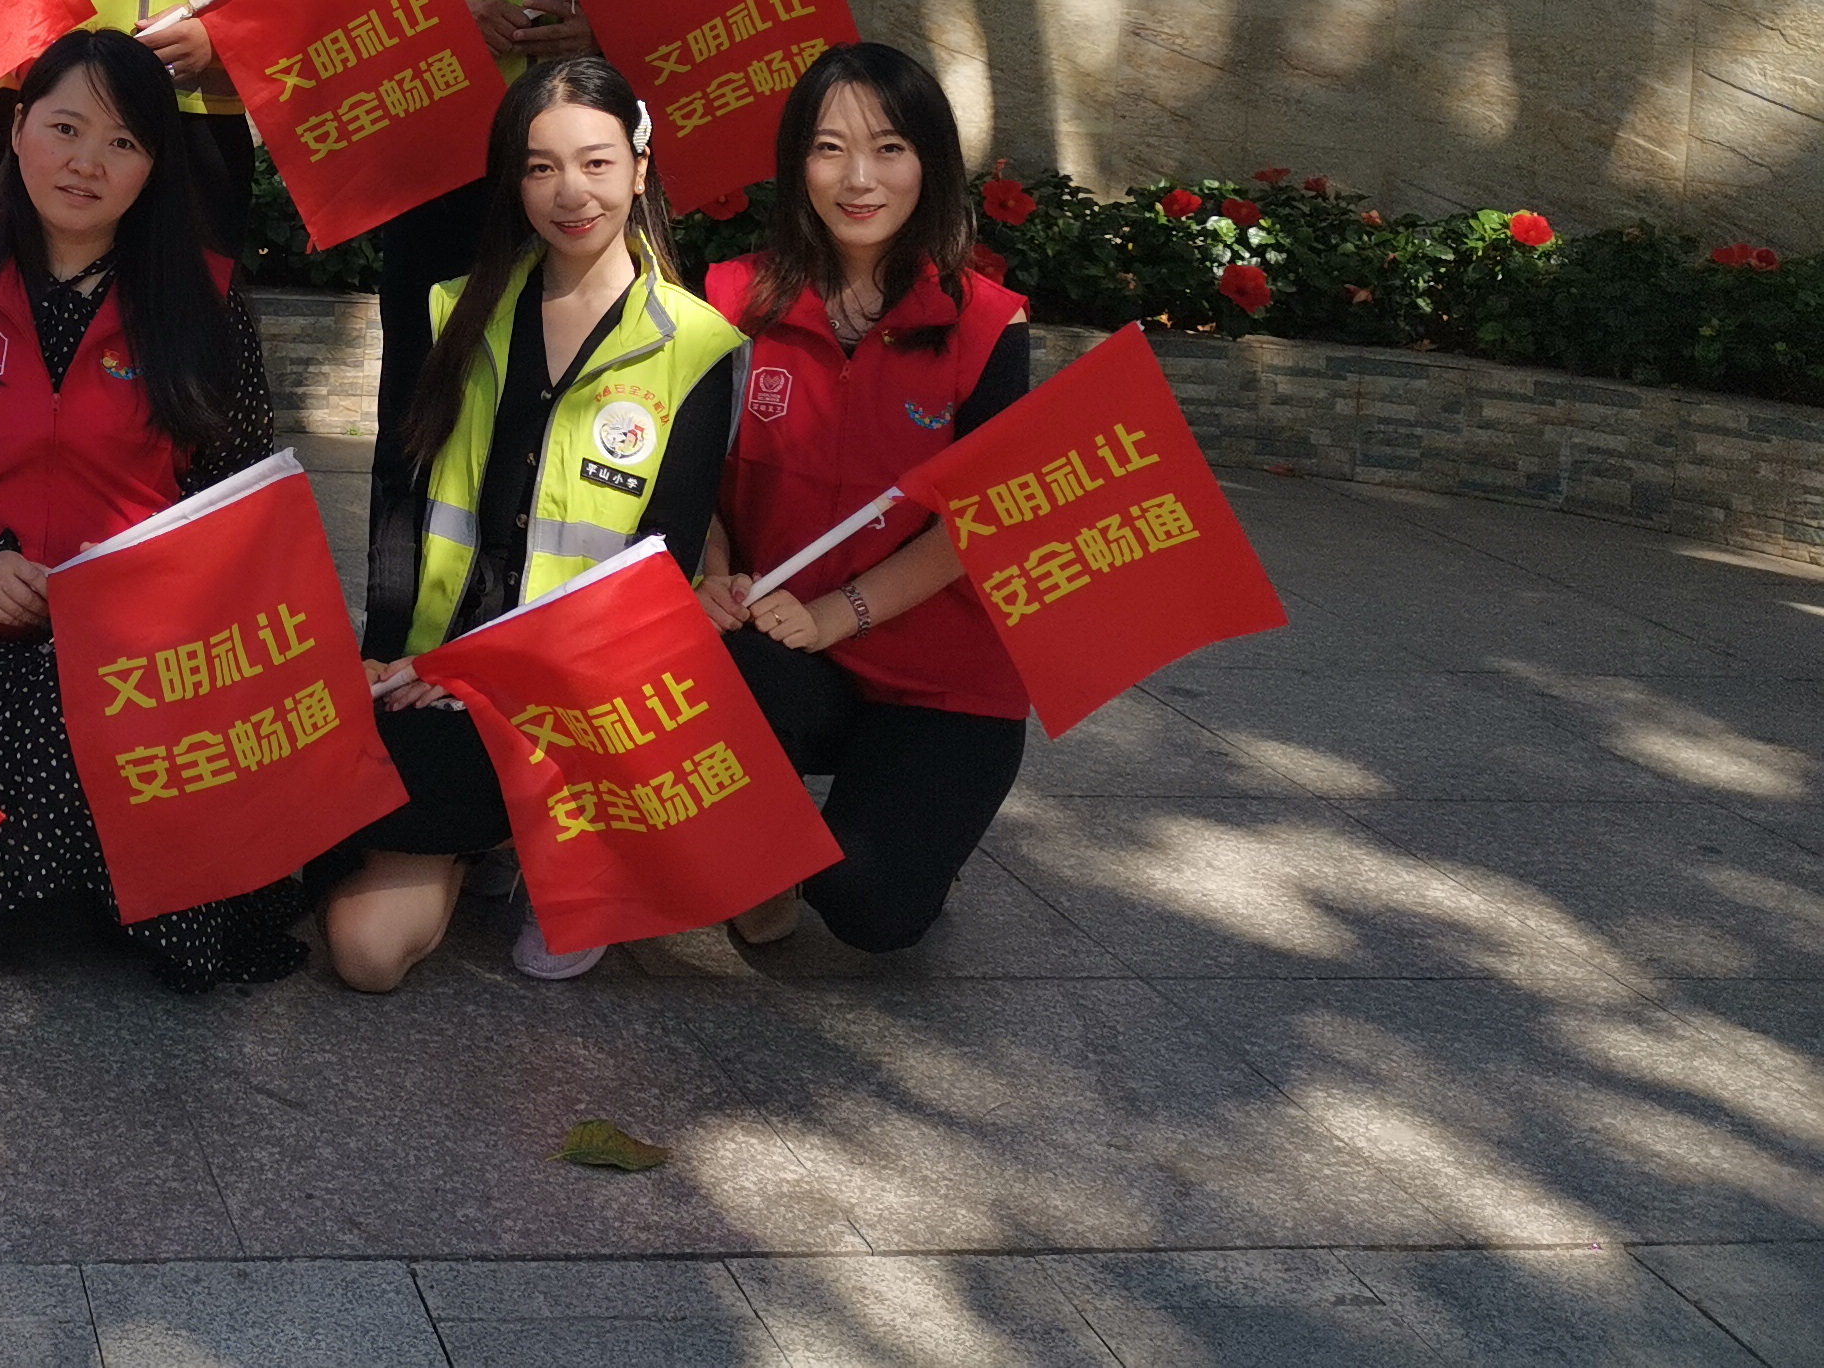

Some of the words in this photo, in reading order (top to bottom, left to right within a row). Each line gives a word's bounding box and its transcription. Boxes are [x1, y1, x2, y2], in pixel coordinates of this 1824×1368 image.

[296, 49, 471, 163] 安全畅通
[585, 462, 639, 489] 平山小学
[948, 422, 1160, 551] 文明礼让
[981, 492, 1200, 628] 安全畅通
[97, 602, 316, 717] 文明礼让
[115, 679, 341, 805] 安全畅通
[510, 671, 710, 765] 文明礼让
[547, 740, 752, 843] 安全畅通
